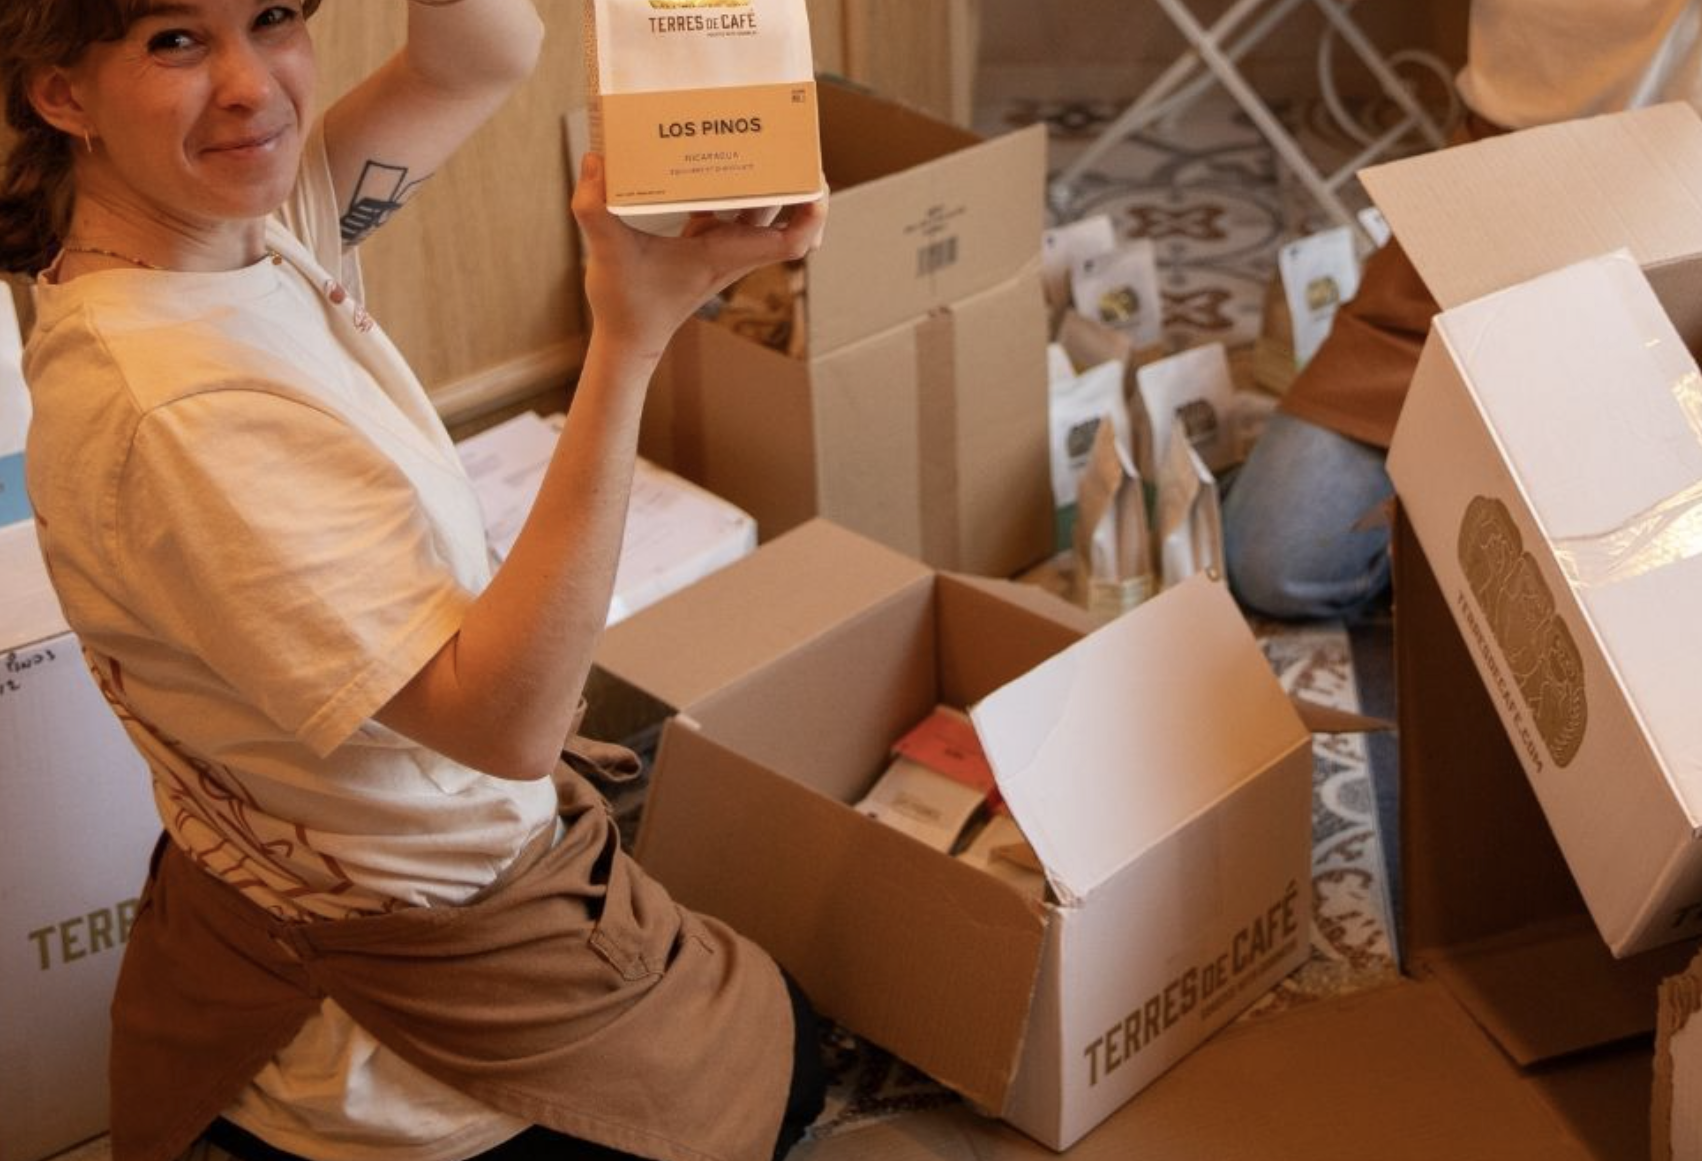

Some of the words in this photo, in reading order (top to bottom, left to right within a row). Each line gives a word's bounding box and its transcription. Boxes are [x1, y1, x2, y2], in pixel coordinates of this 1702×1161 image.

[648, 15, 704, 33] TERRES
[706, 17, 720, 30] DE
[720, 7, 757, 29] CAFÉ
[658, 122, 696, 138] LOS
[702, 117, 762, 135] PINOS
[685, 151, 739, 162] NICARAGUA
[1084, 967, 1198, 1087] TERRES
[1201, 954, 1229, 999] DE
[1232, 880, 1299, 975] CAFÉ
